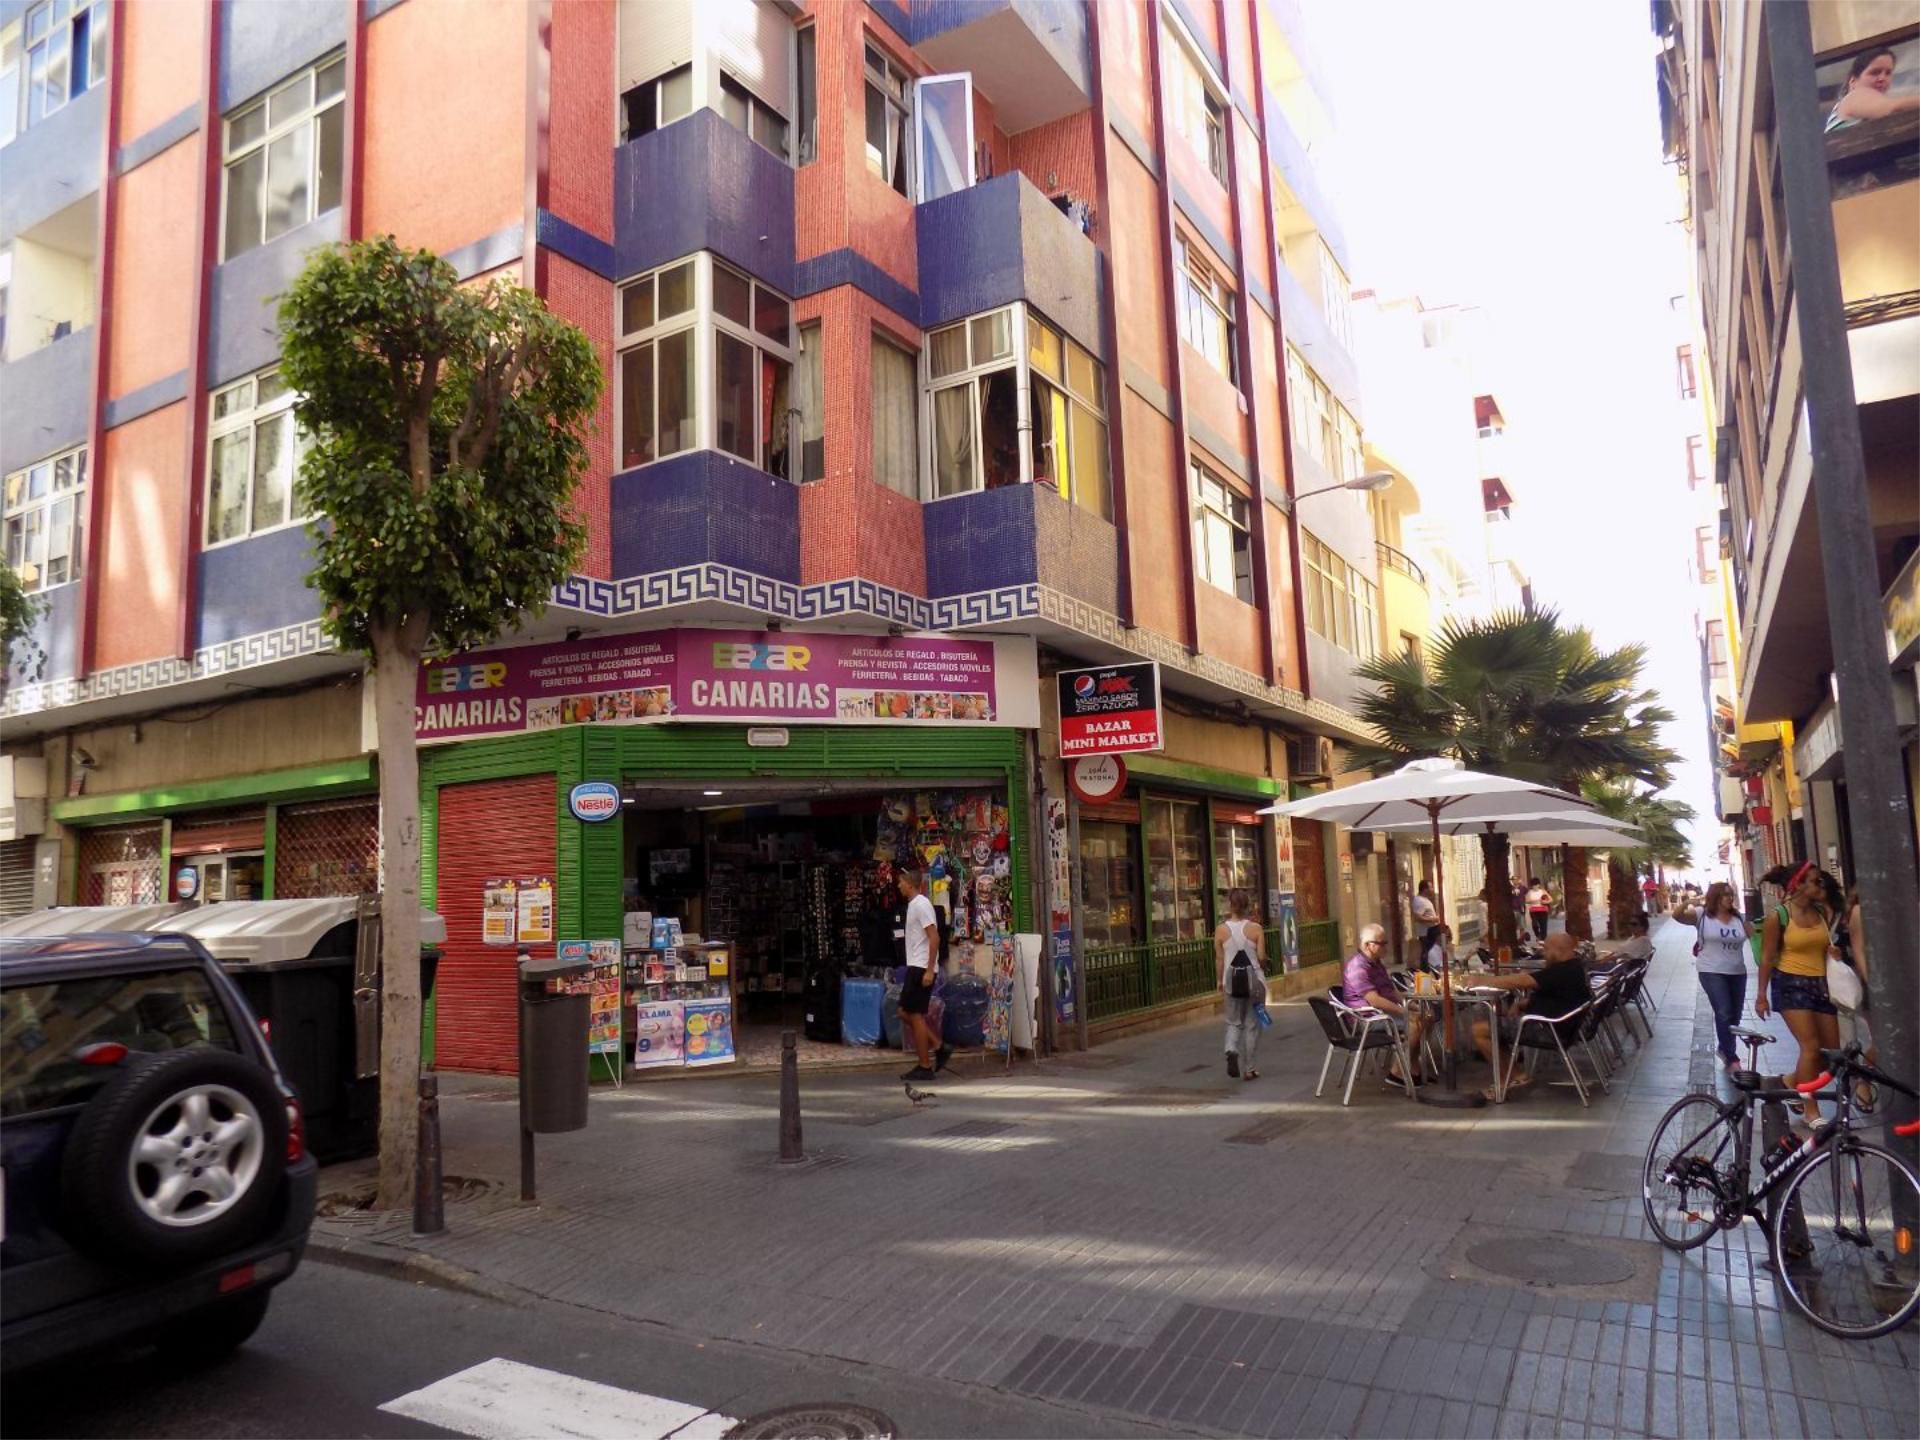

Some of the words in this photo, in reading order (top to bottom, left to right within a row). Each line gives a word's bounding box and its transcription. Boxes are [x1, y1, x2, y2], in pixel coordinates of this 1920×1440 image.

[580, 652, 590, 661] DE
[591, 649, 619, 660] REGALO
[895, 650, 904, 658] DE
[906, 650, 936, 659] REGALO
[529, 667, 557, 678] PRENSA
[557, 667, 563, 675] Y
[564, 664, 593, 675] REVISTA
[598, 658, 642, 670] ACCESORIOS
[838, 659, 868, 668] PRENSA
[869, 660, 875, 668] Y
[877, 660, 908, 670] REVISTA
[912, 661, 958, 671] ACCESORIOS
[588, 671, 618, 683] BEBIDAS
[623, 668, 652, 680] TABACO
[903, 672, 935, 682] BEBIDAS
[939, 673, 968, 683] TABACO
[691, 679, 830, 709] CANARIAS
[1085, 720, 1132, 734] BAZAR
[1063, 738, 1095, 750] MINI
[1098, 732, 1157, 747] MARKET
